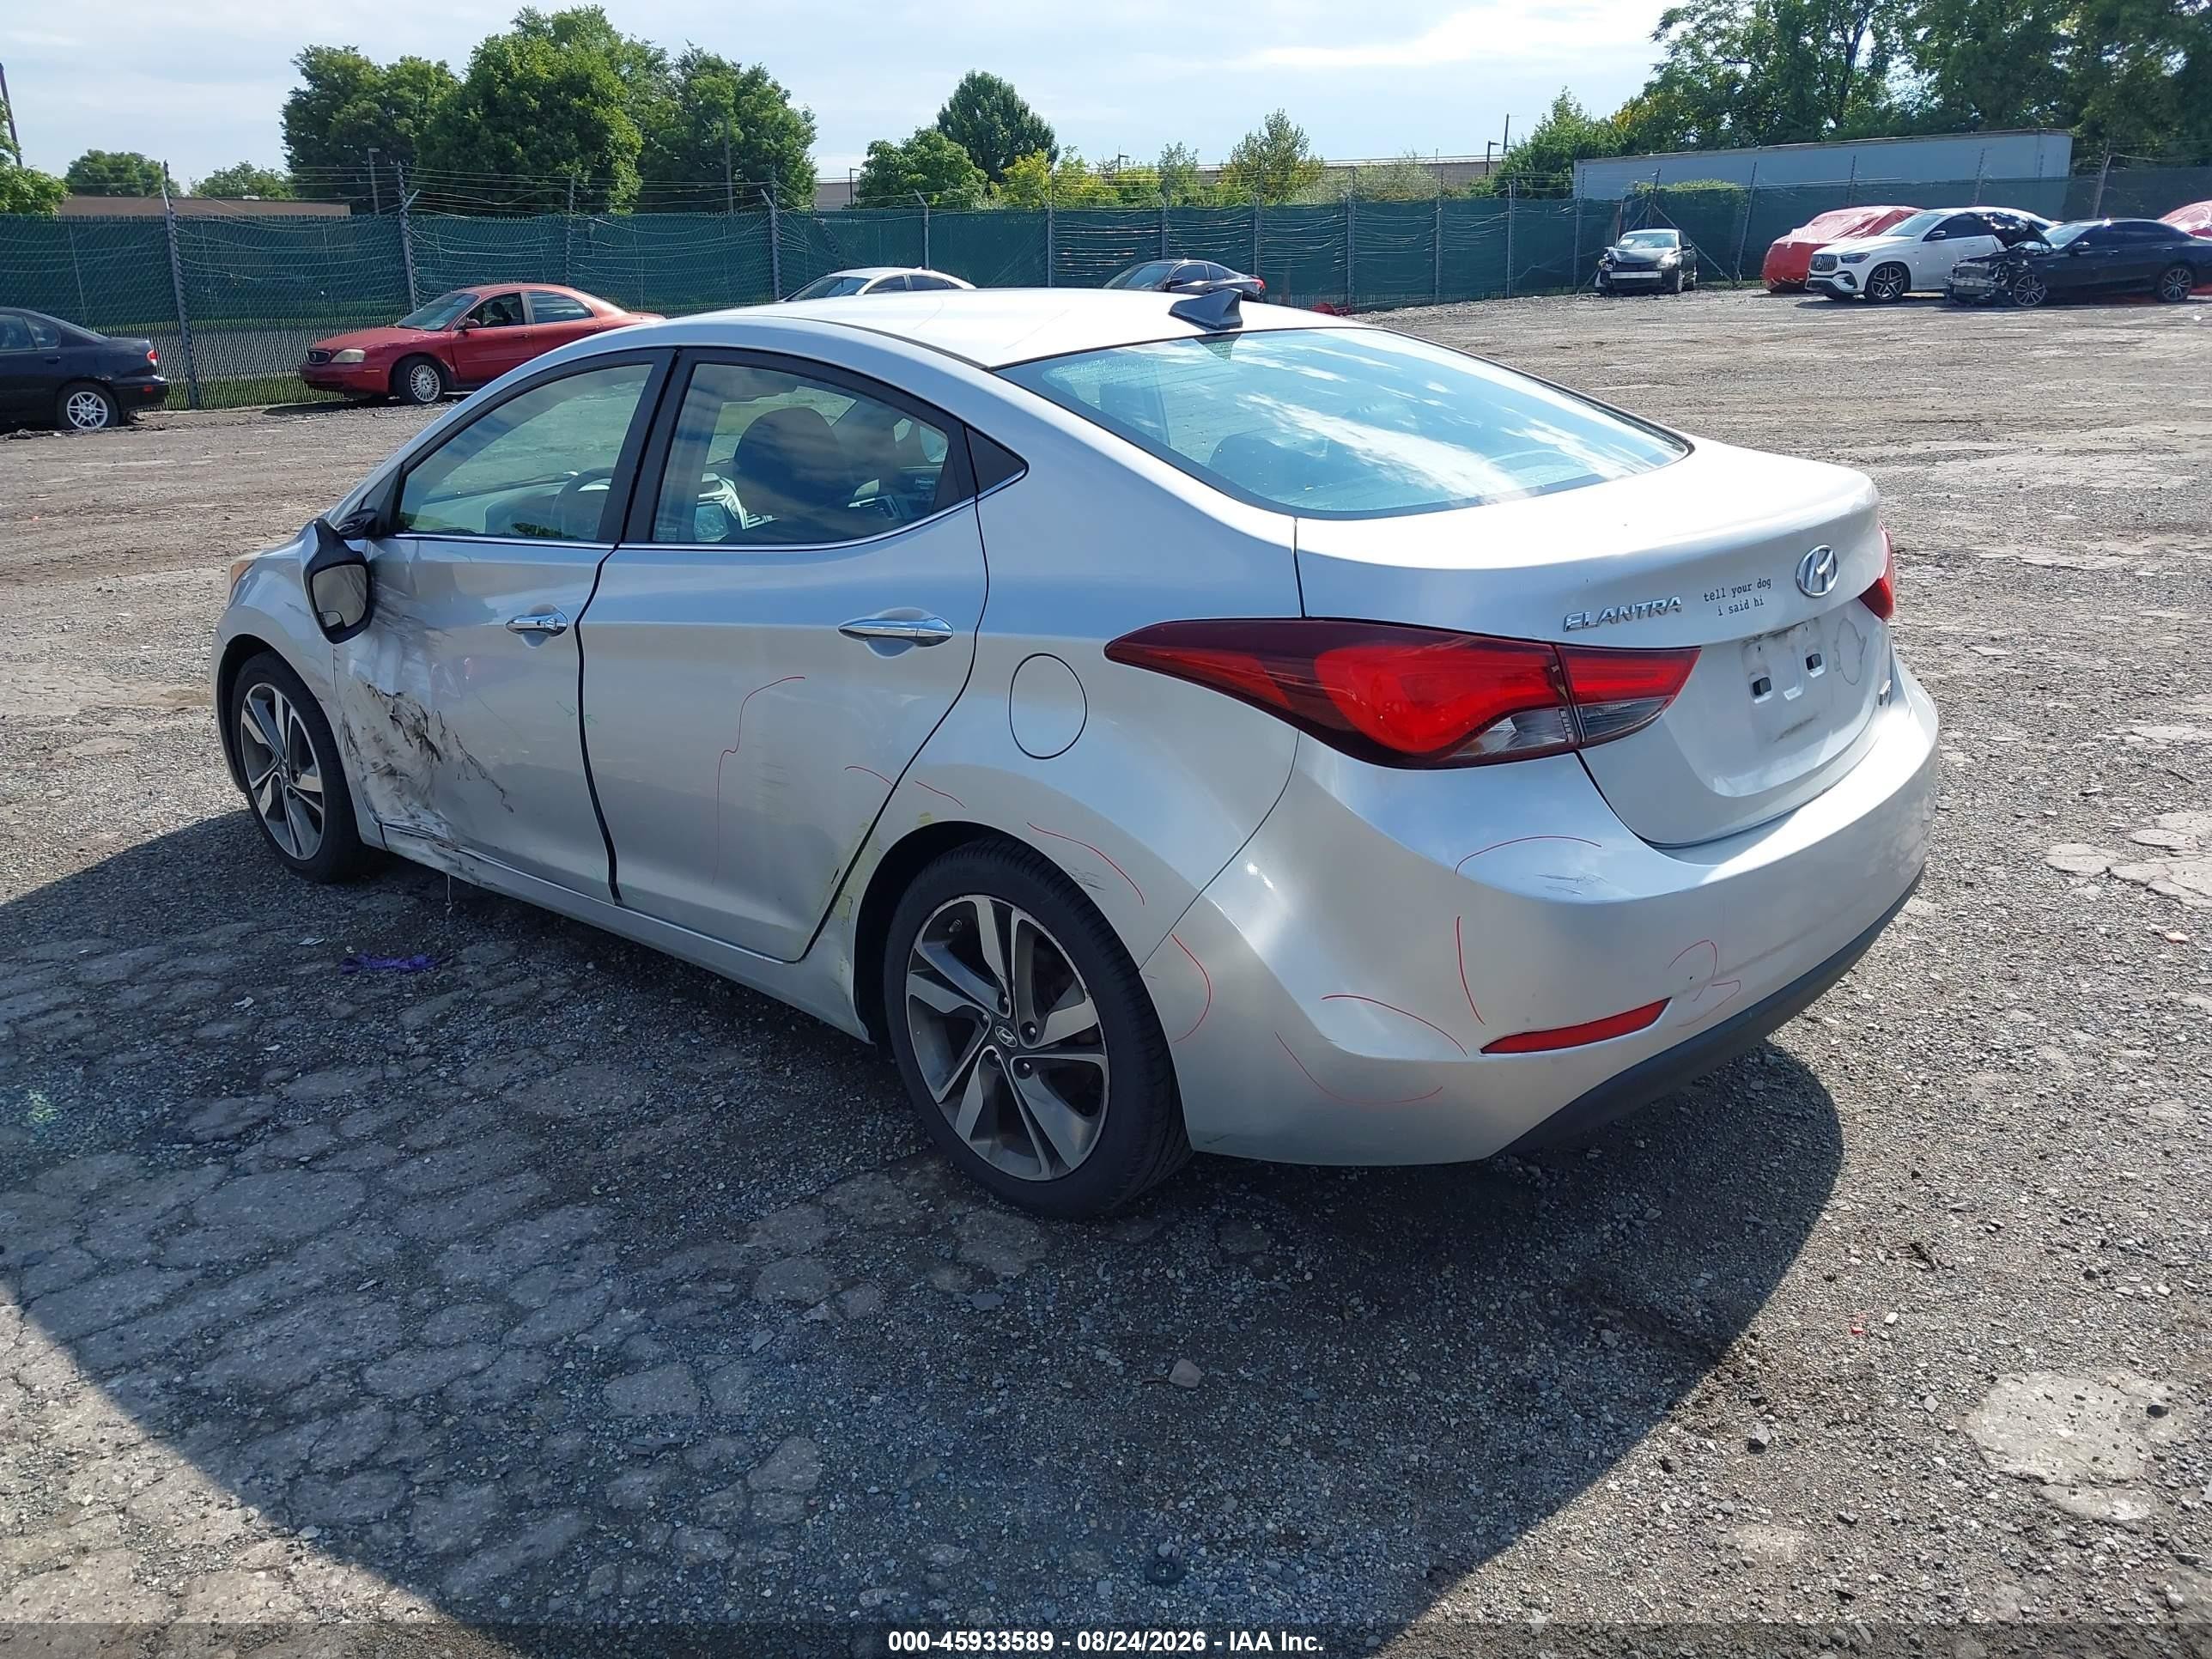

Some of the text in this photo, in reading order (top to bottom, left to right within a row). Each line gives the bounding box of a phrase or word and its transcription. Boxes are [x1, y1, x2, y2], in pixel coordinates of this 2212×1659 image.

[1704, 578, 1771, 602] tell your dog
[1563, 595, 1683, 632] ELANTRA
[1717, 593, 1765, 617] i said hi
